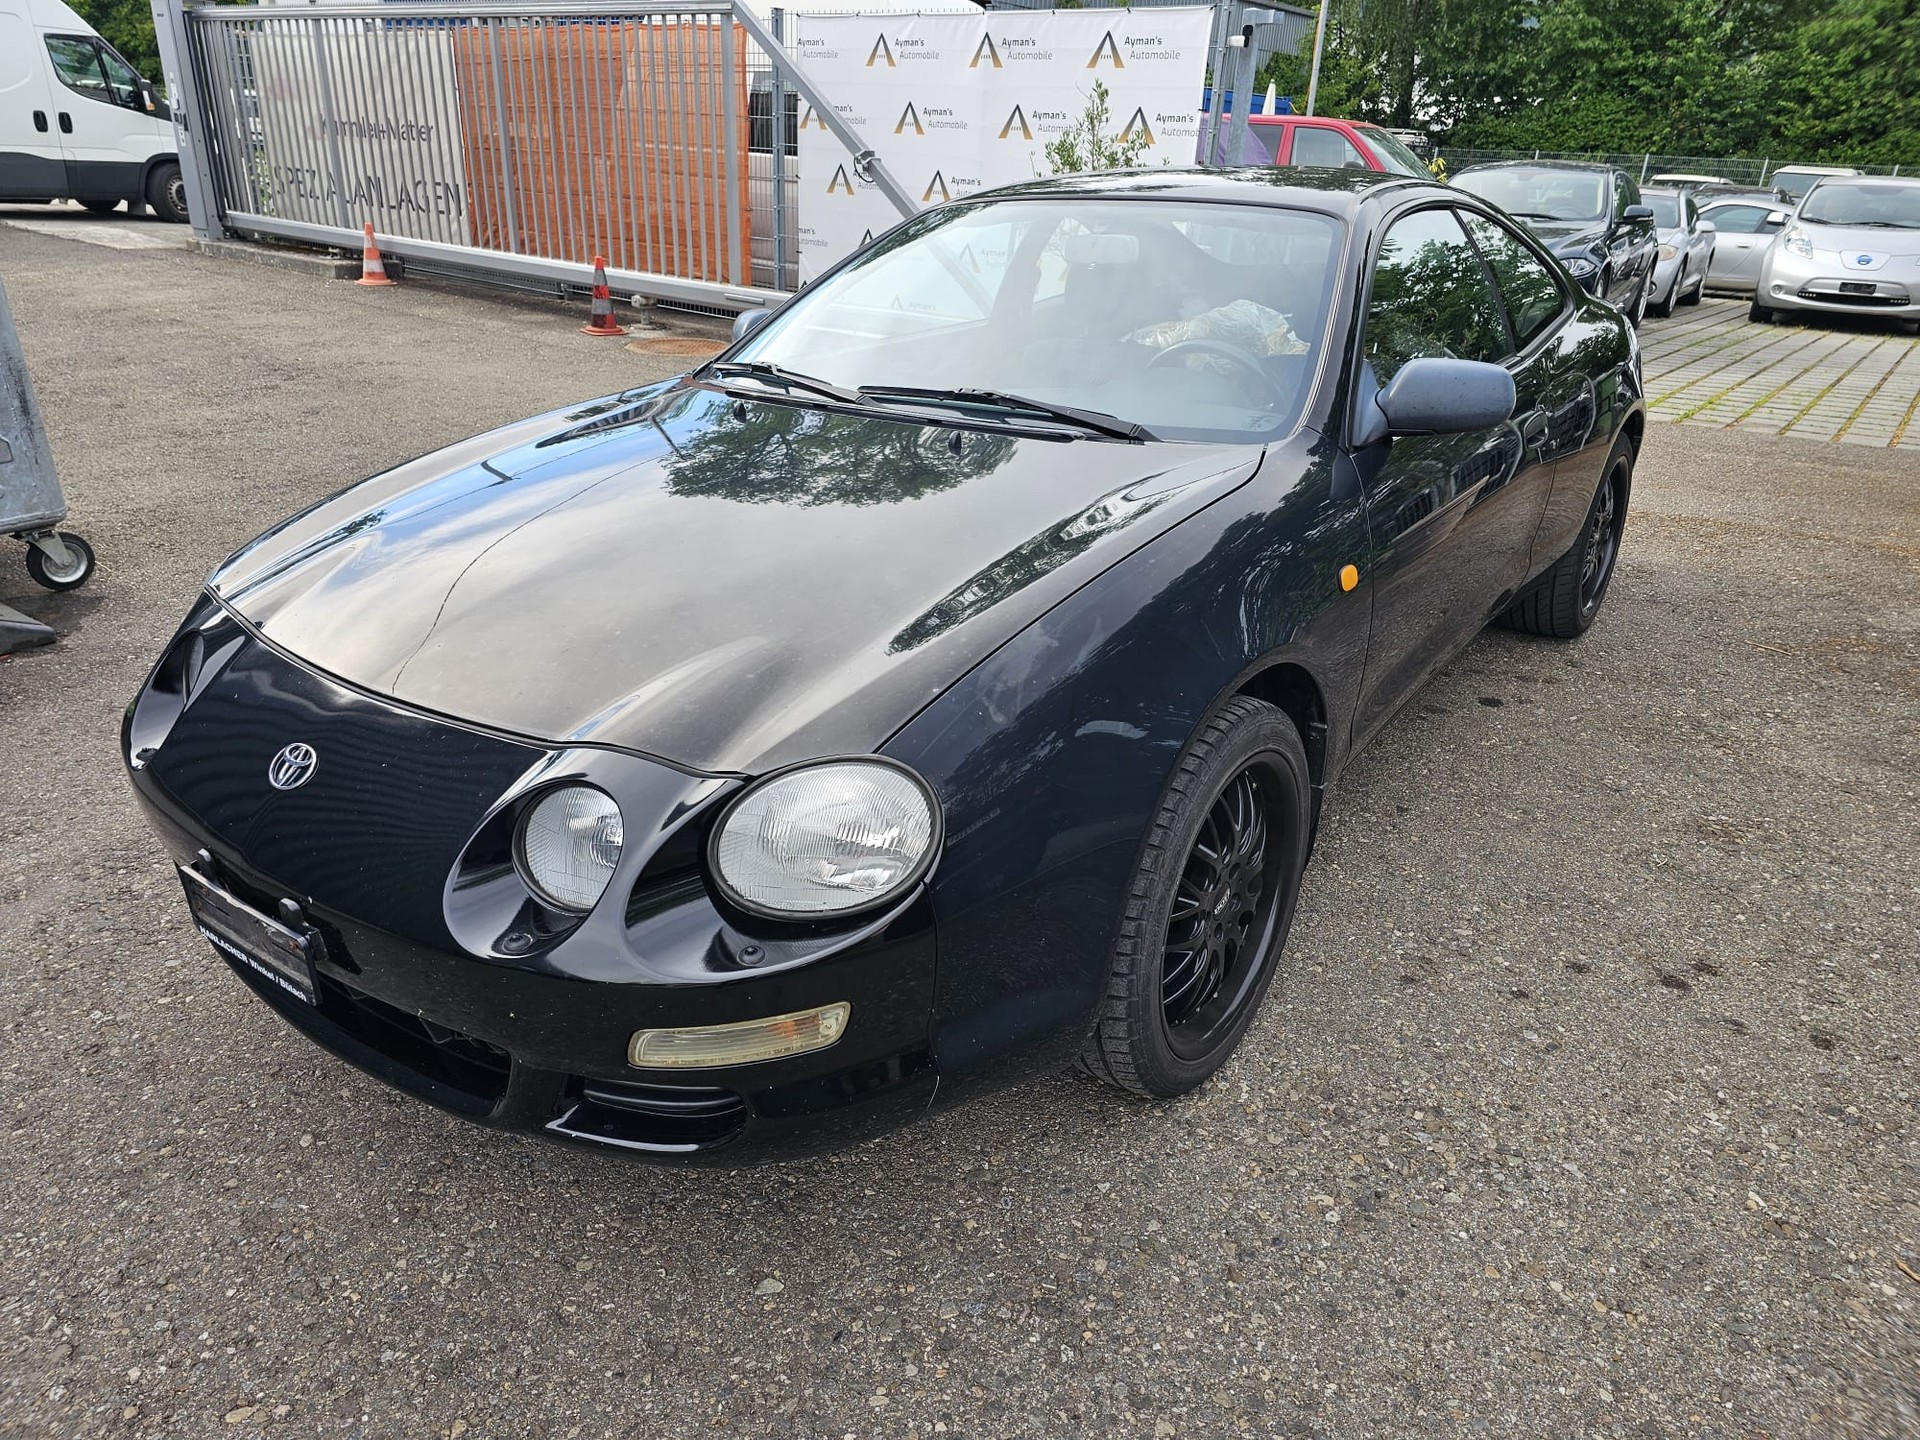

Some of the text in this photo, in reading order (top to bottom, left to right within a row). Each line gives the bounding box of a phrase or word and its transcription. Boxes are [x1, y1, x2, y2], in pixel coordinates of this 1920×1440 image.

[797, 38, 825, 48] Ayman's
[894, 38, 925, 48] Ayman's
[1001, 37, 1036, 48] Ayman's
[1124, 36, 1163, 48] Ayman's
[802, 50, 839, 59] Automobile
[899, 51, 940, 60] Automobile
[1007, 51, 1053, 61] Automobile
[1129, 50, 1181, 60] Automobile
[833, 104, 853, 113] man's
[922, 107, 953, 118] Ayman's
[1032, 110, 1067, 120] Ayman's
[1155, 113, 1194, 125] Ayman's
[844, 117, 867, 125] mobile
[927, 120, 968, 130] Automobile
[1160, 127, 1200, 137] Automob
[950, 176, 981, 186] Ayman's
[274, 165, 463, 217] SPEZAANLAGEN
